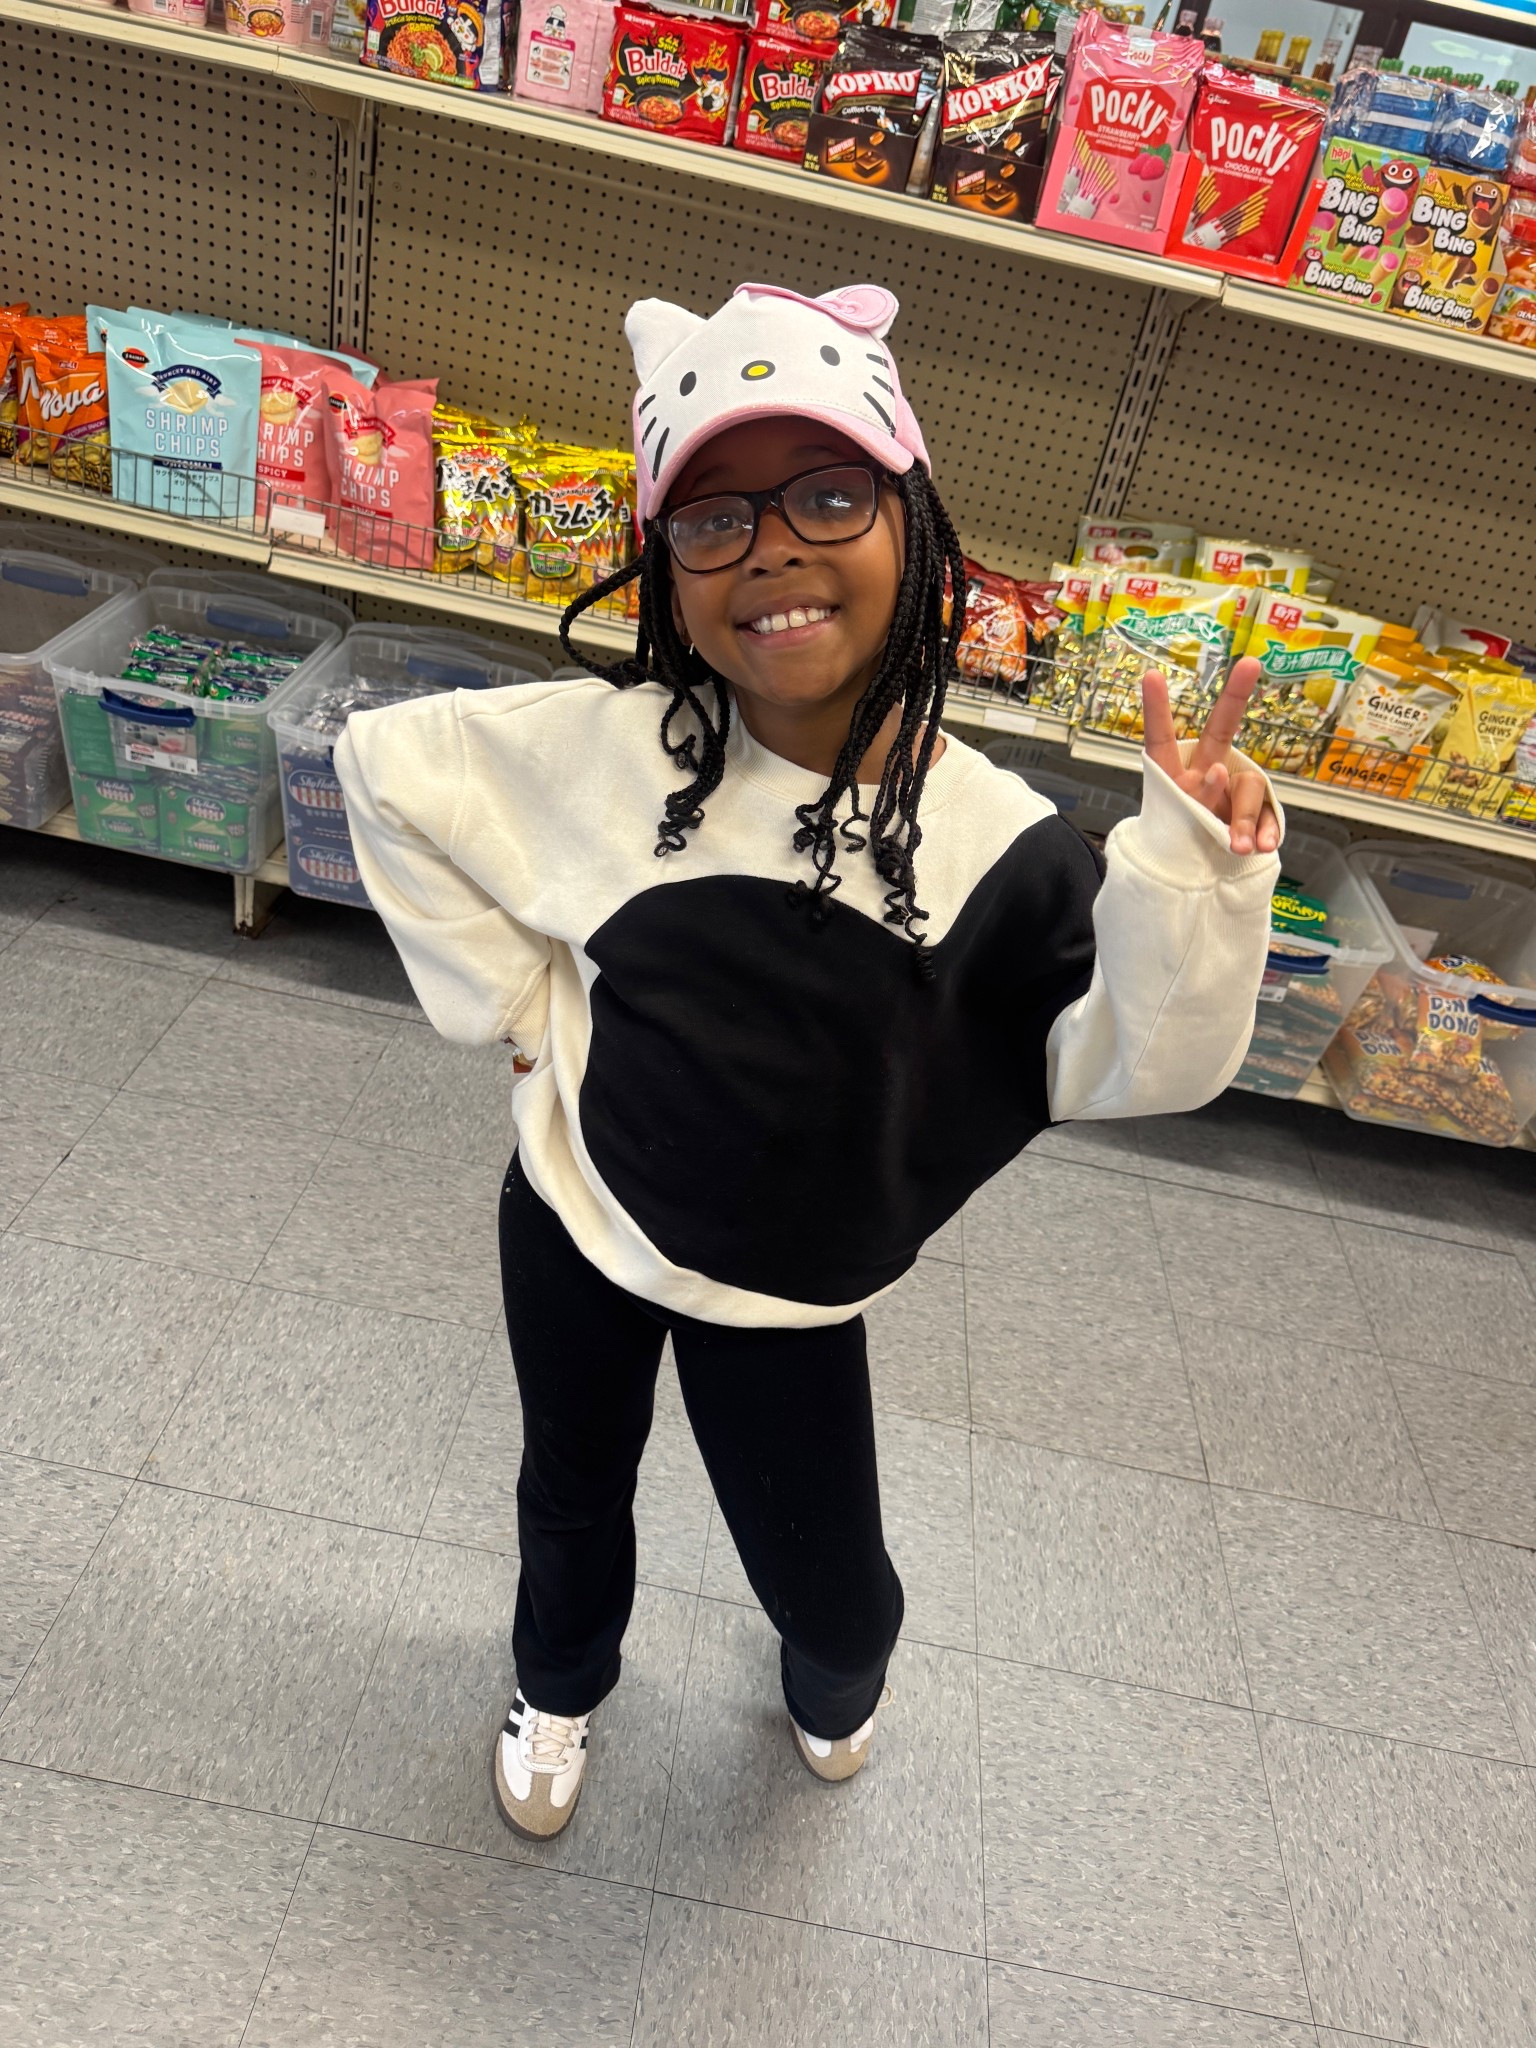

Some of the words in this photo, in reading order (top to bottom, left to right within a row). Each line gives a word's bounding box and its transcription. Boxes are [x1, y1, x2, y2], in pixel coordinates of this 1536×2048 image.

[409, 22, 434, 32] Ramen
[657, 36, 679, 54] Spicy
[625, 47, 688, 80] Buldak
[636, 74, 656, 87] Spicy
[655, 75, 680, 90] Ramen
[824, 71, 917, 104] KOPIKO
[947, 62, 1044, 122] KOPIKO
[1208, 93, 1231, 105] Glico
[842, 106, 865, 117] Coffee
[966, 130, 990, 144] Coffee
[1097, 124, 1141, 141] STRAWBERRY
[829, 139, 856, 156] KOPIKO
[1224, 161, 1263, 176] CHOCOLATE
[957, 170, 986, 188] KOPIKO
[186, 367, 201, 377] AND
[202, 373, 219, 387] AIRY
[19, 365, 106, 422] Nova
[146, 409, 229, 438] SHRIMP
[155, 432, 220, 458] CHIPS
[258, 441, 304, 468] HIPS
[257, 464, 288, 478] SPICY
[341, 477, 391, 508] CHIPS
[1274, 605, 1300, 622] 春光
[1368, 695, 1420, 722] GINGER
[1479, 710, 1518, 728] GINGER
[1477, 722, 1512, 738] CHEWS
[1329, 759, 1388, 784] GINGER
[1430, 996, 1465, 1012] DIN
[1428, 1014, 1479, 1037] DONG
[1362, 1043, 1402, 1057] DON
